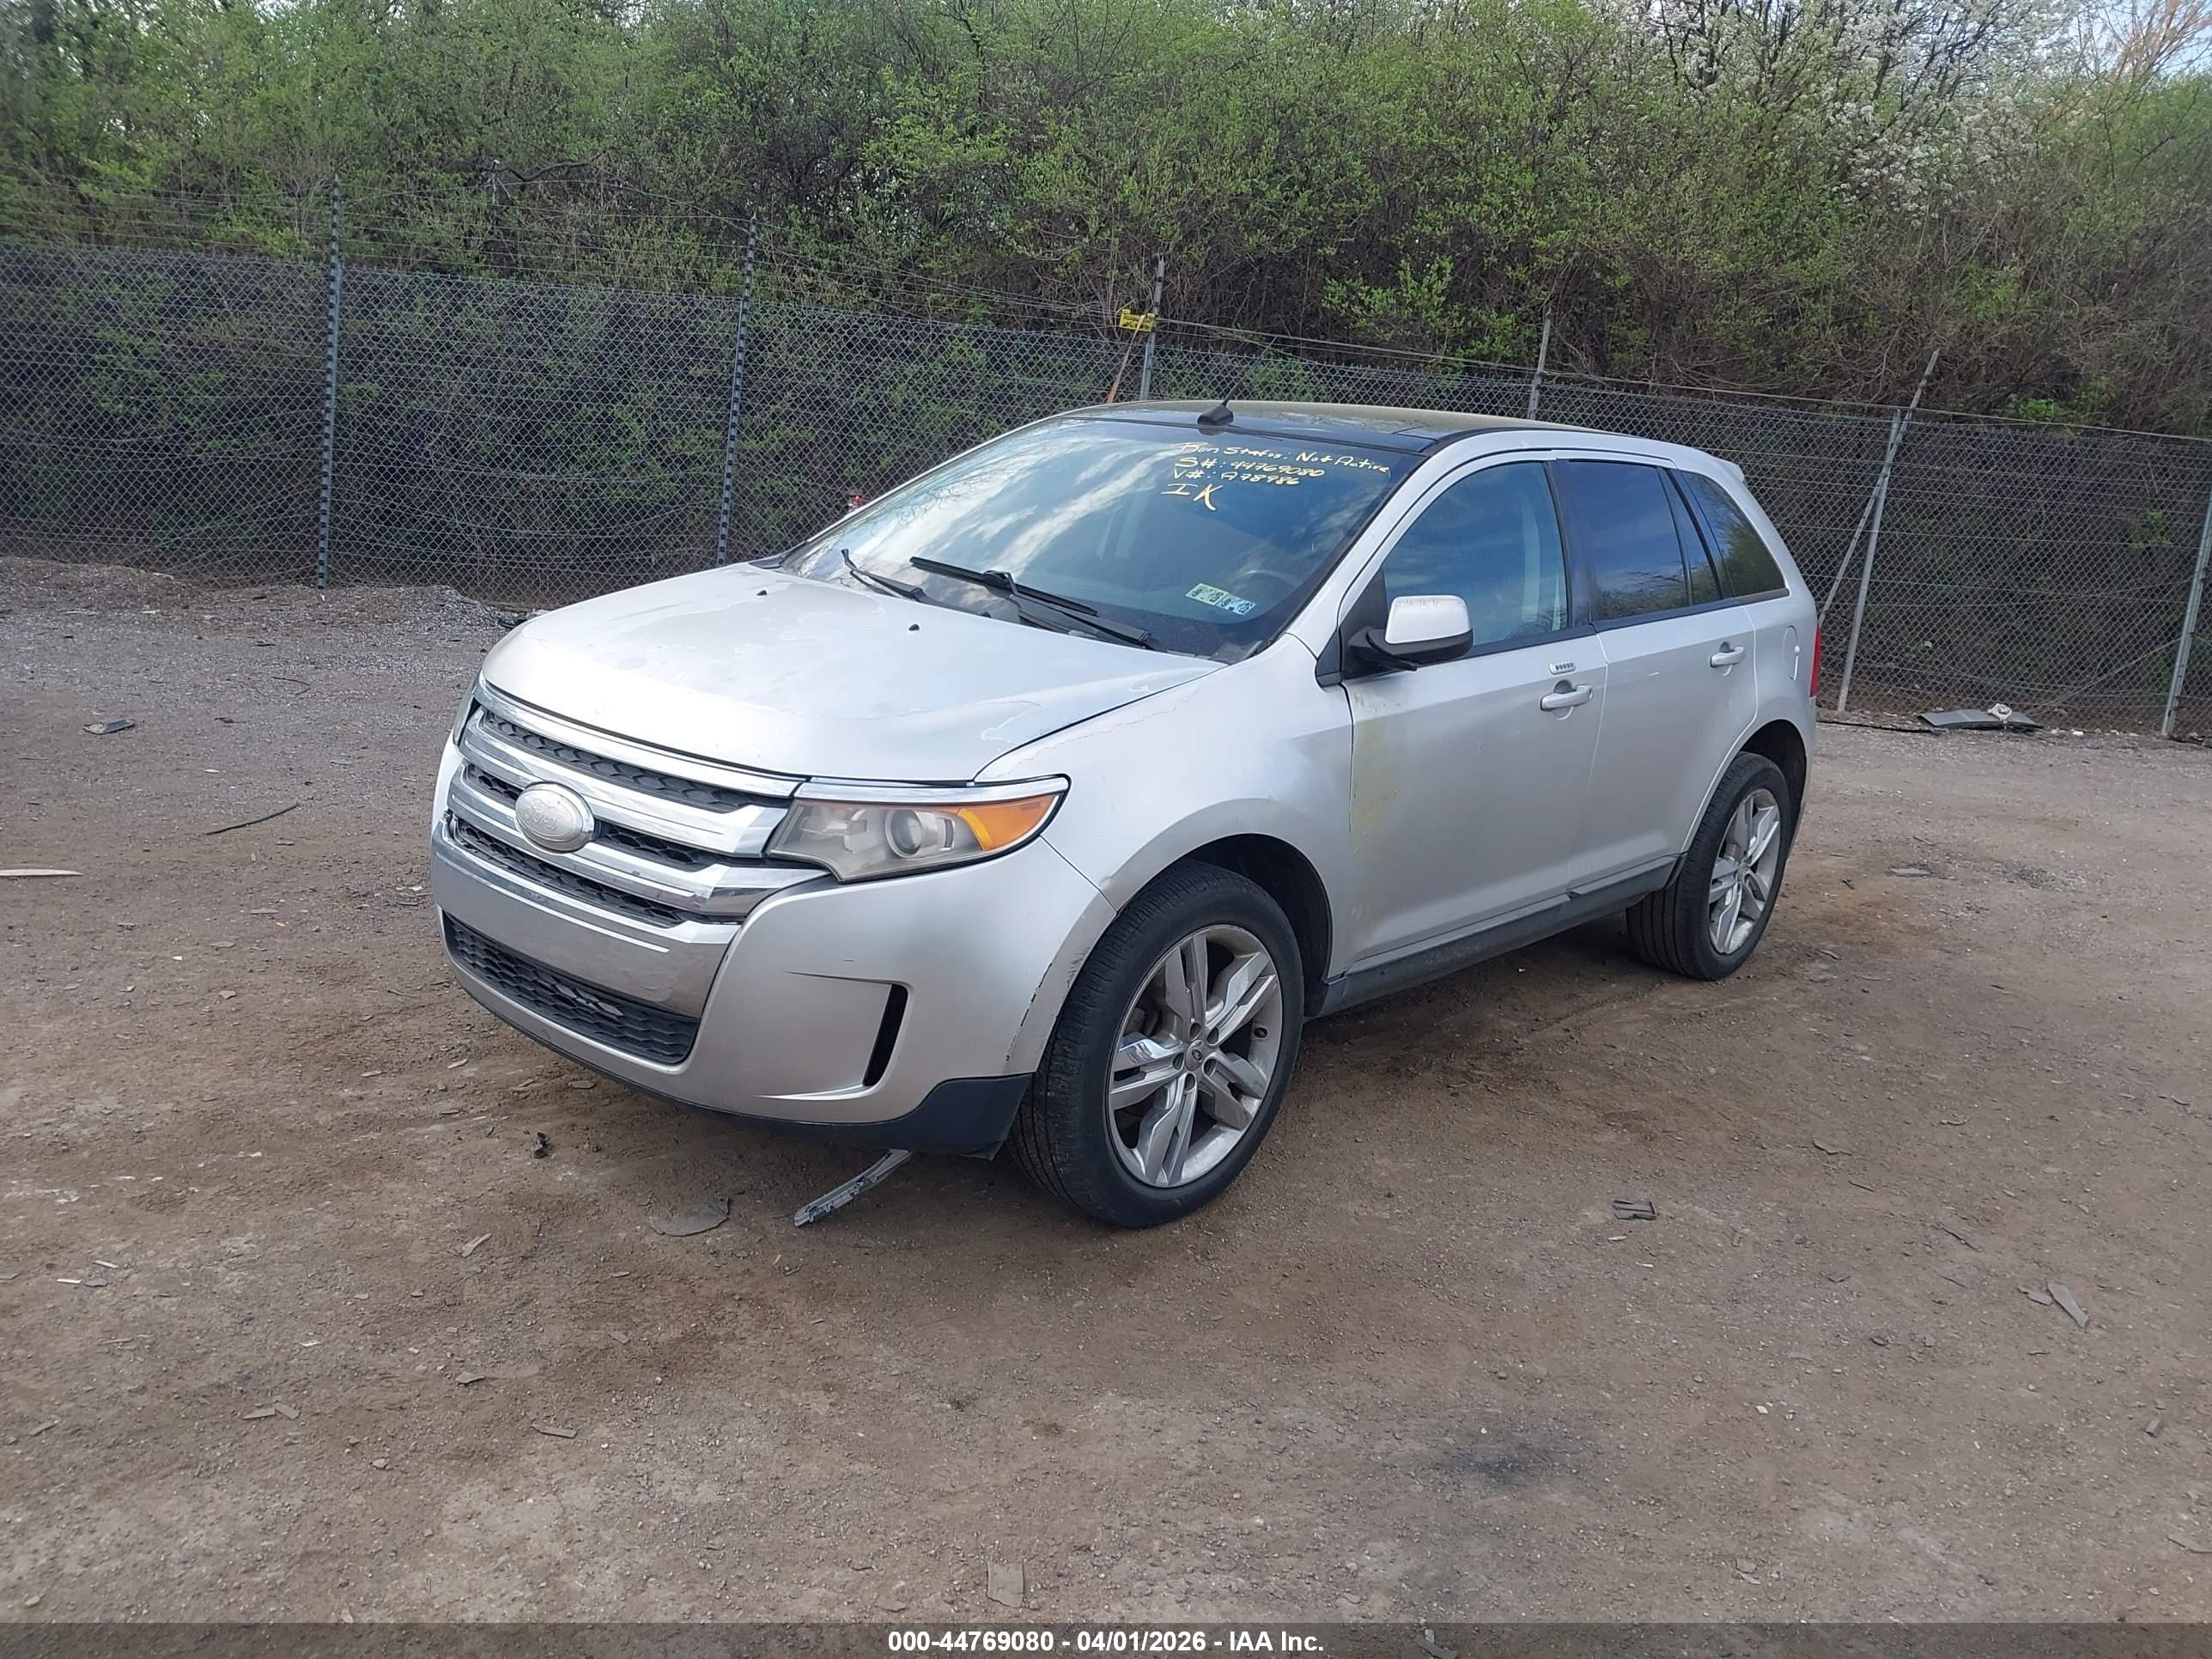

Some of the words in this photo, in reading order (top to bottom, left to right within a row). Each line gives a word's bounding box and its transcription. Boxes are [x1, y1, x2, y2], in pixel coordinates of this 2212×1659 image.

[1230, 460, 1326, 478] 44769080
[1296, 452, 1334, 464] Not
[1334, 456, 1391, 474] Active
